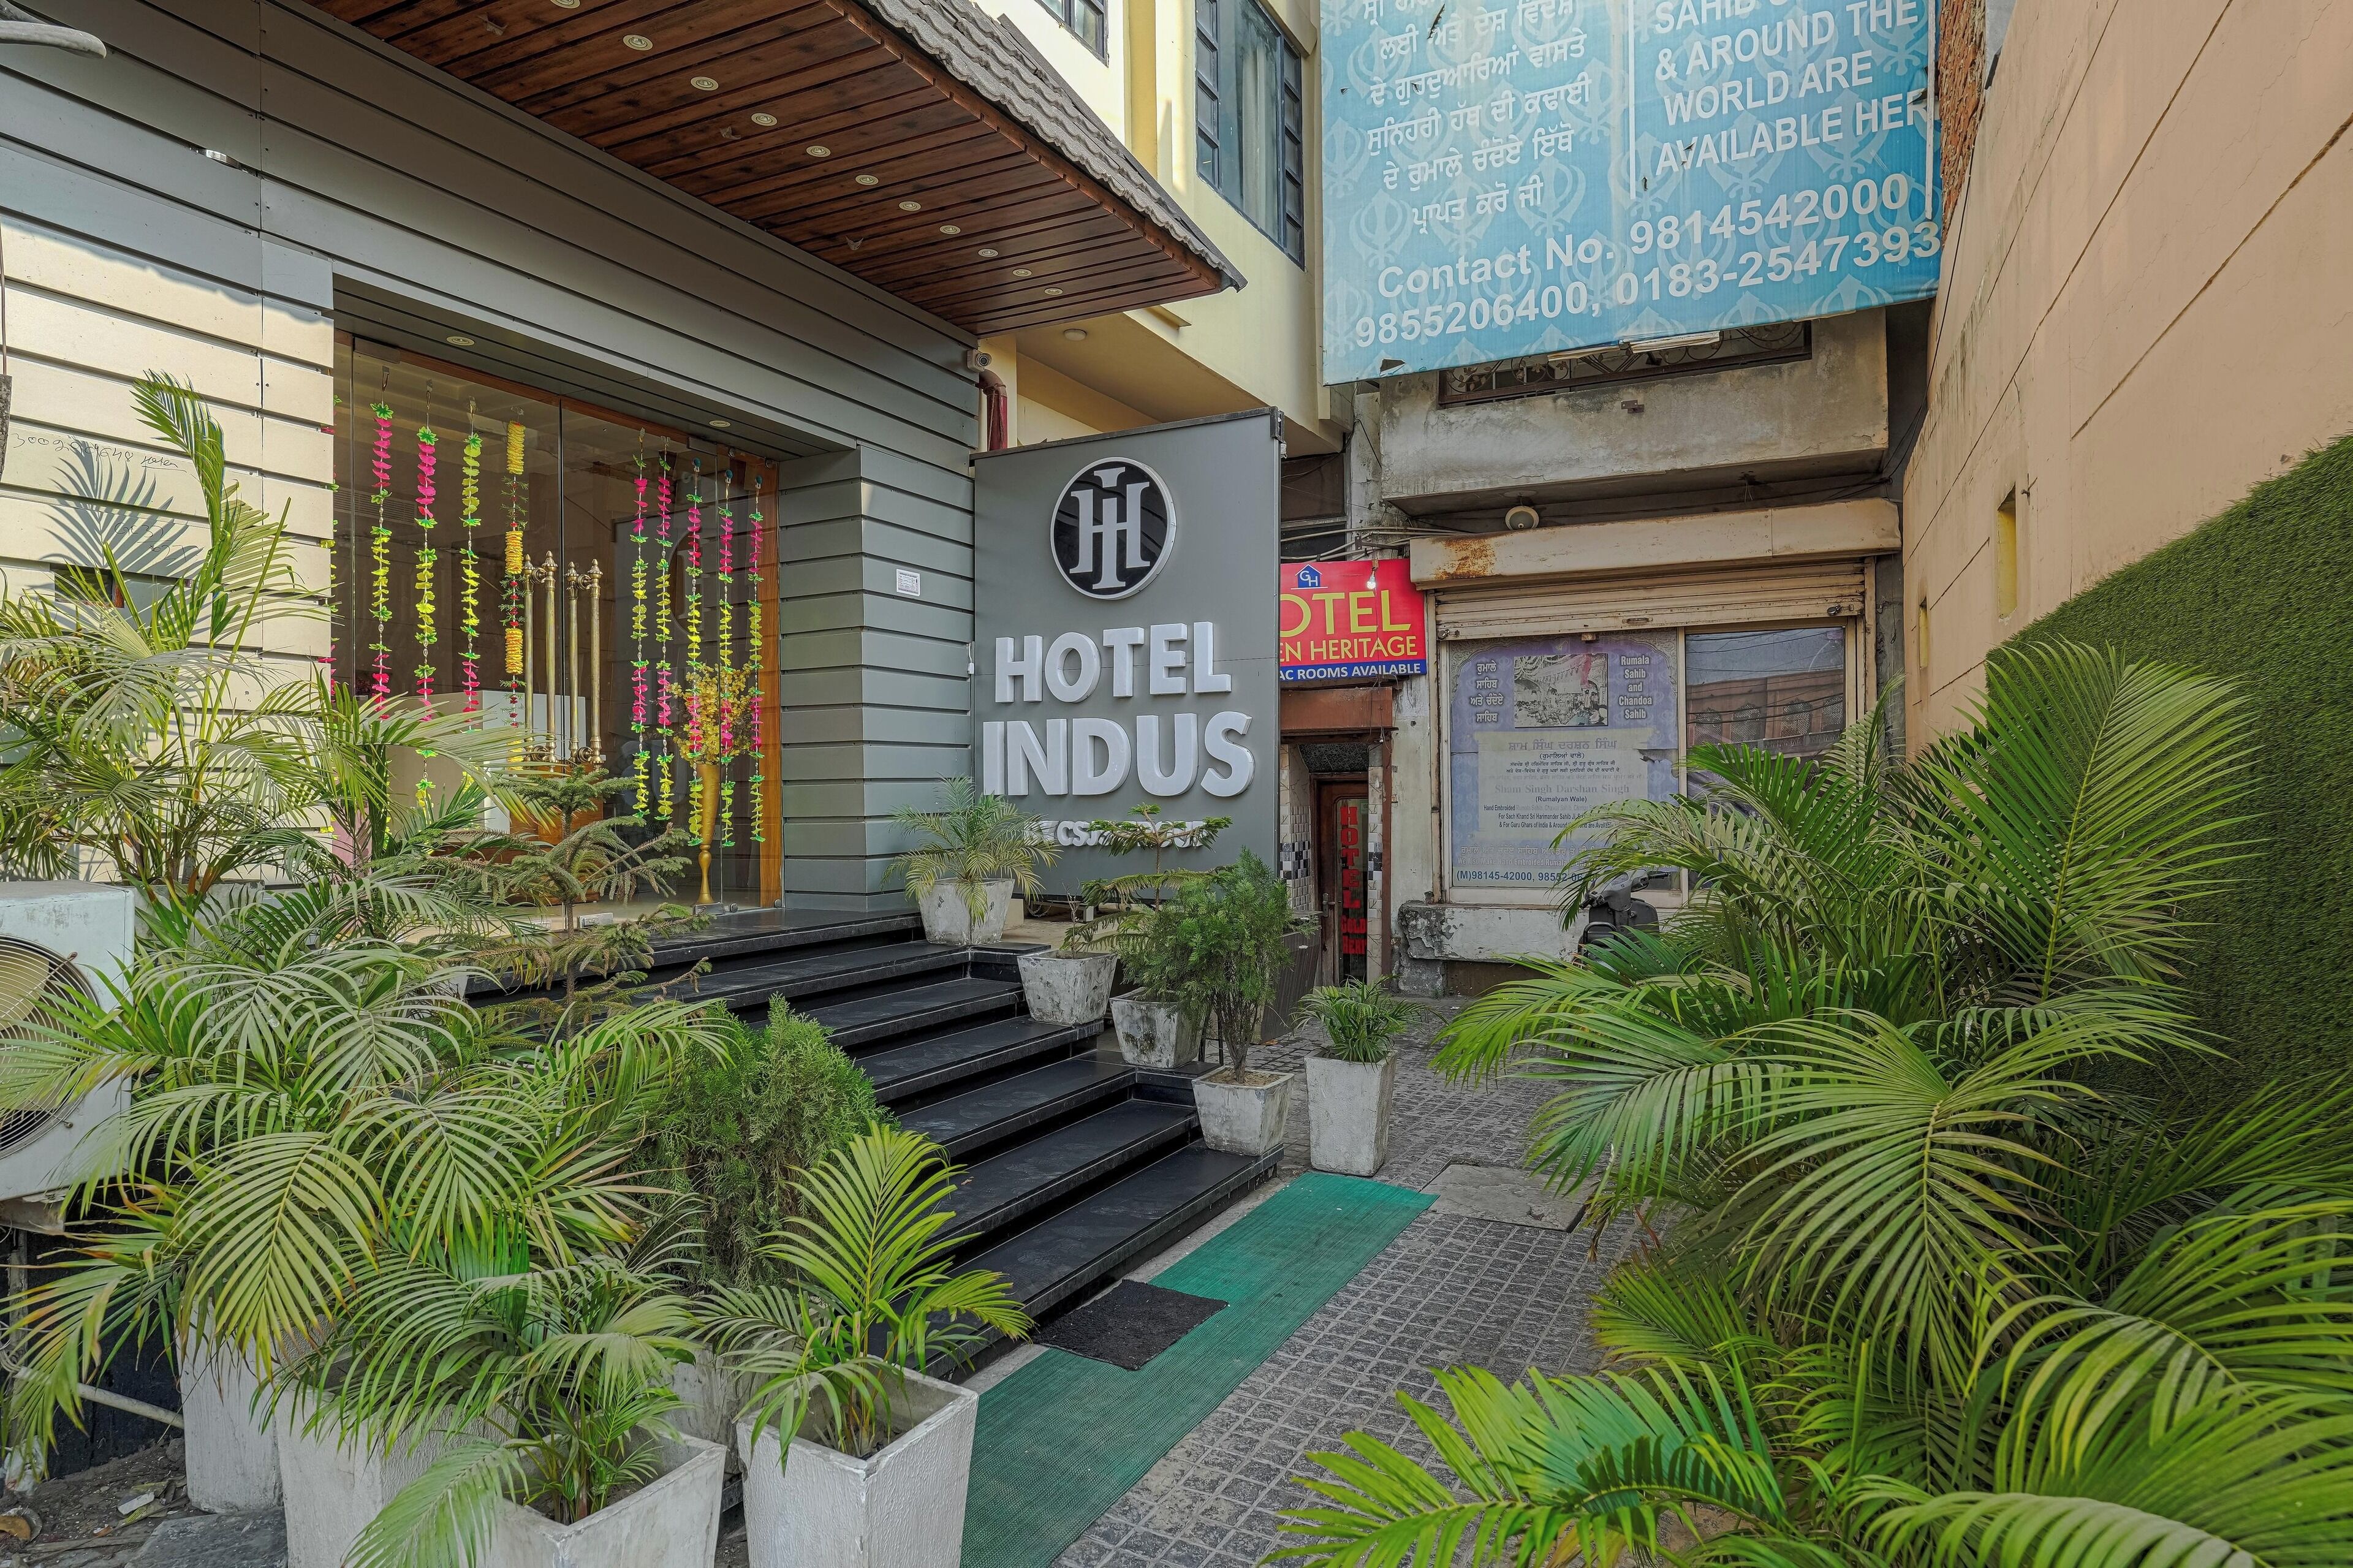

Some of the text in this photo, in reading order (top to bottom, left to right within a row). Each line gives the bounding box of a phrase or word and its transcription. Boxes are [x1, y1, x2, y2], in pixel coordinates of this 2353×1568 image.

[1380, 23, 1419, 59] ਲਈ
[1474, 6, 1507, 35] ਦੇਸ਼
[1656, 0, 1919, 81] & AROUND THE
[1370, 76, 1386, 105] ਦੇ
[1529, 28, 1588, 68] ਵਾਸਤੇ
[1664, 50, 1874, 126] WORLD ARE
[1450, 100, 1482, 131] ਹੱਥ
[1491, 90, 1515, 122] ਦੀ
[1525, 72, 1593, 113] ਕਢਾਈ
[1656, 87, 1940, 176] AVAILABLE HER
[1383, 161, 1400, 190] ਦੇ
[1409, 148, 1464, 191] ਰੁਮਾਲੇ
[1412, 175, 1544, 235] ਪ੍ਰਾਪਤ ਕਰੋ ਜੀ
[1378, 173, 1908, 298] Contact No. 9814542000
[1355, 221, 1941, 347] 9855206400, 0183-2547393
[1300, 570, 1318, 587] GH
[1310, 635, 1418, 661] HERITAGE
[1621, 655, 1650, 665] Rumala
[995, 621, 1232, 703] HOTEL
[1297, 667, 1348, 680] ROOMS
[1352, 663, 1421, 676] AVAILABLE
[1477, 660, 1496, 675] ਰੁਮਾਲੇ
[1624, 668, 1646, 679] Sahib
[1476, 676, 1498, 689] ਸਾਹਿਬ
[1628, 682, 1642, 692] and
[1470, 694, 1483, 705] ਅਤੇ
[1619, 695, 1652, 706] Chandoa
[1476, 710, 1498, 722] ਸਾਹਿਬ
[1624, 709, 1646, 719] Sahib
[983, 711, 1255, 797] INDUS
[1495, 784, 1629, 795] Sham Singh Darshan Singh
[1340, 806, 1361, 909] HOTEL
[1457, 870, 1535, 882] (M)98145-42000,
